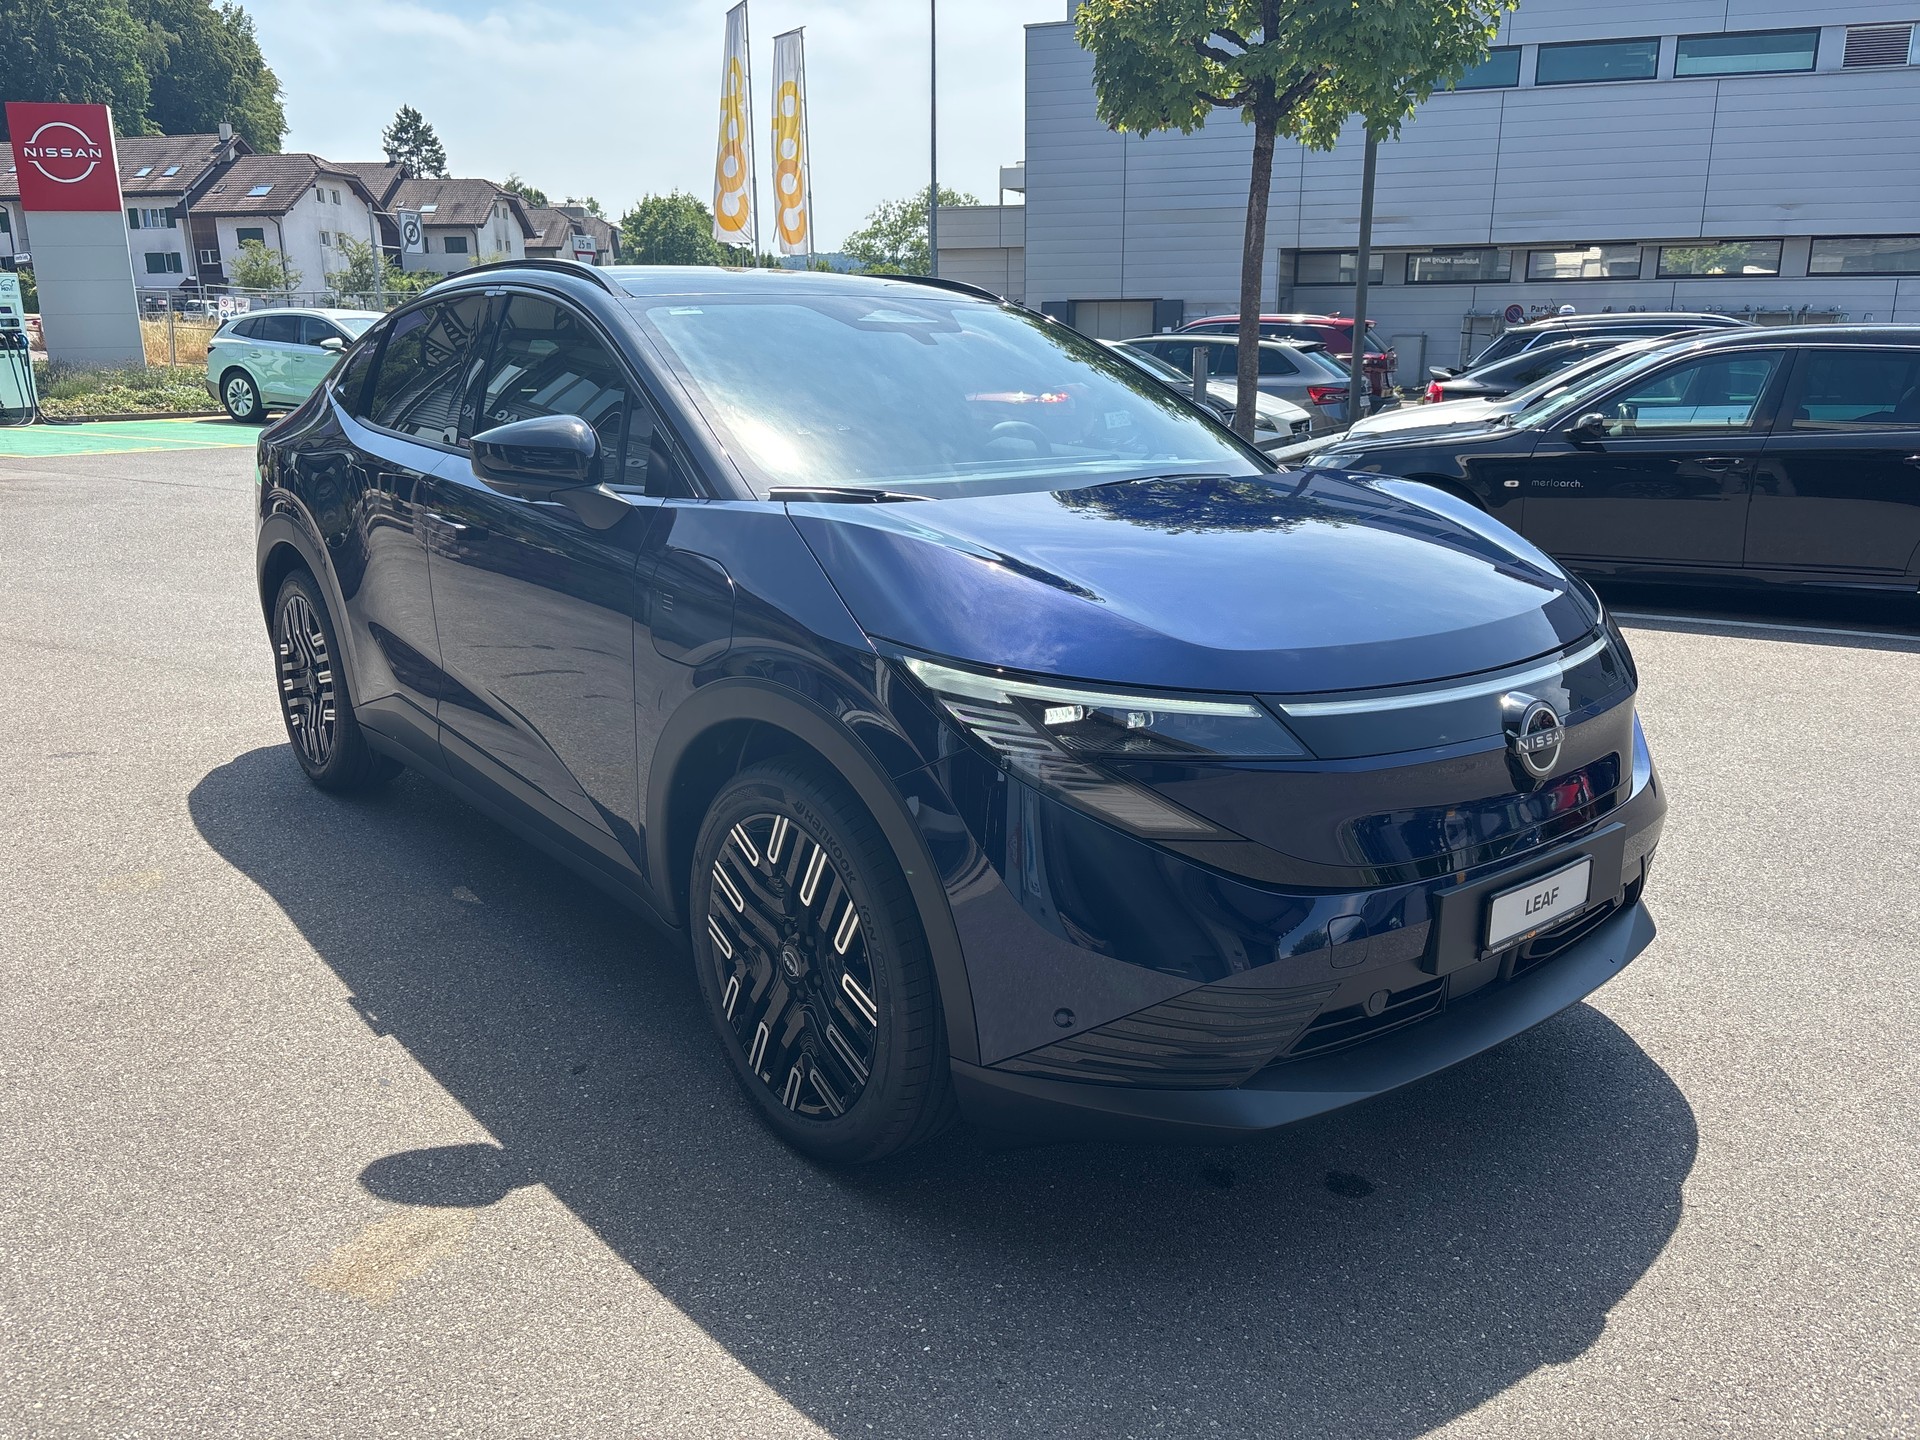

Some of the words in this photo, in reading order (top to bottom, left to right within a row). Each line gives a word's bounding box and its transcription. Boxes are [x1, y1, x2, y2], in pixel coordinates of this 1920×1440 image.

[23, 147, 102, 158] NISSAN
[578, 240, 585, 249] 25
[1531, 480, 1584, 488] merloarch.
[1518, 729, 1565, 752] NISSAN
[1525, 886, 1560, 916] LEAF
